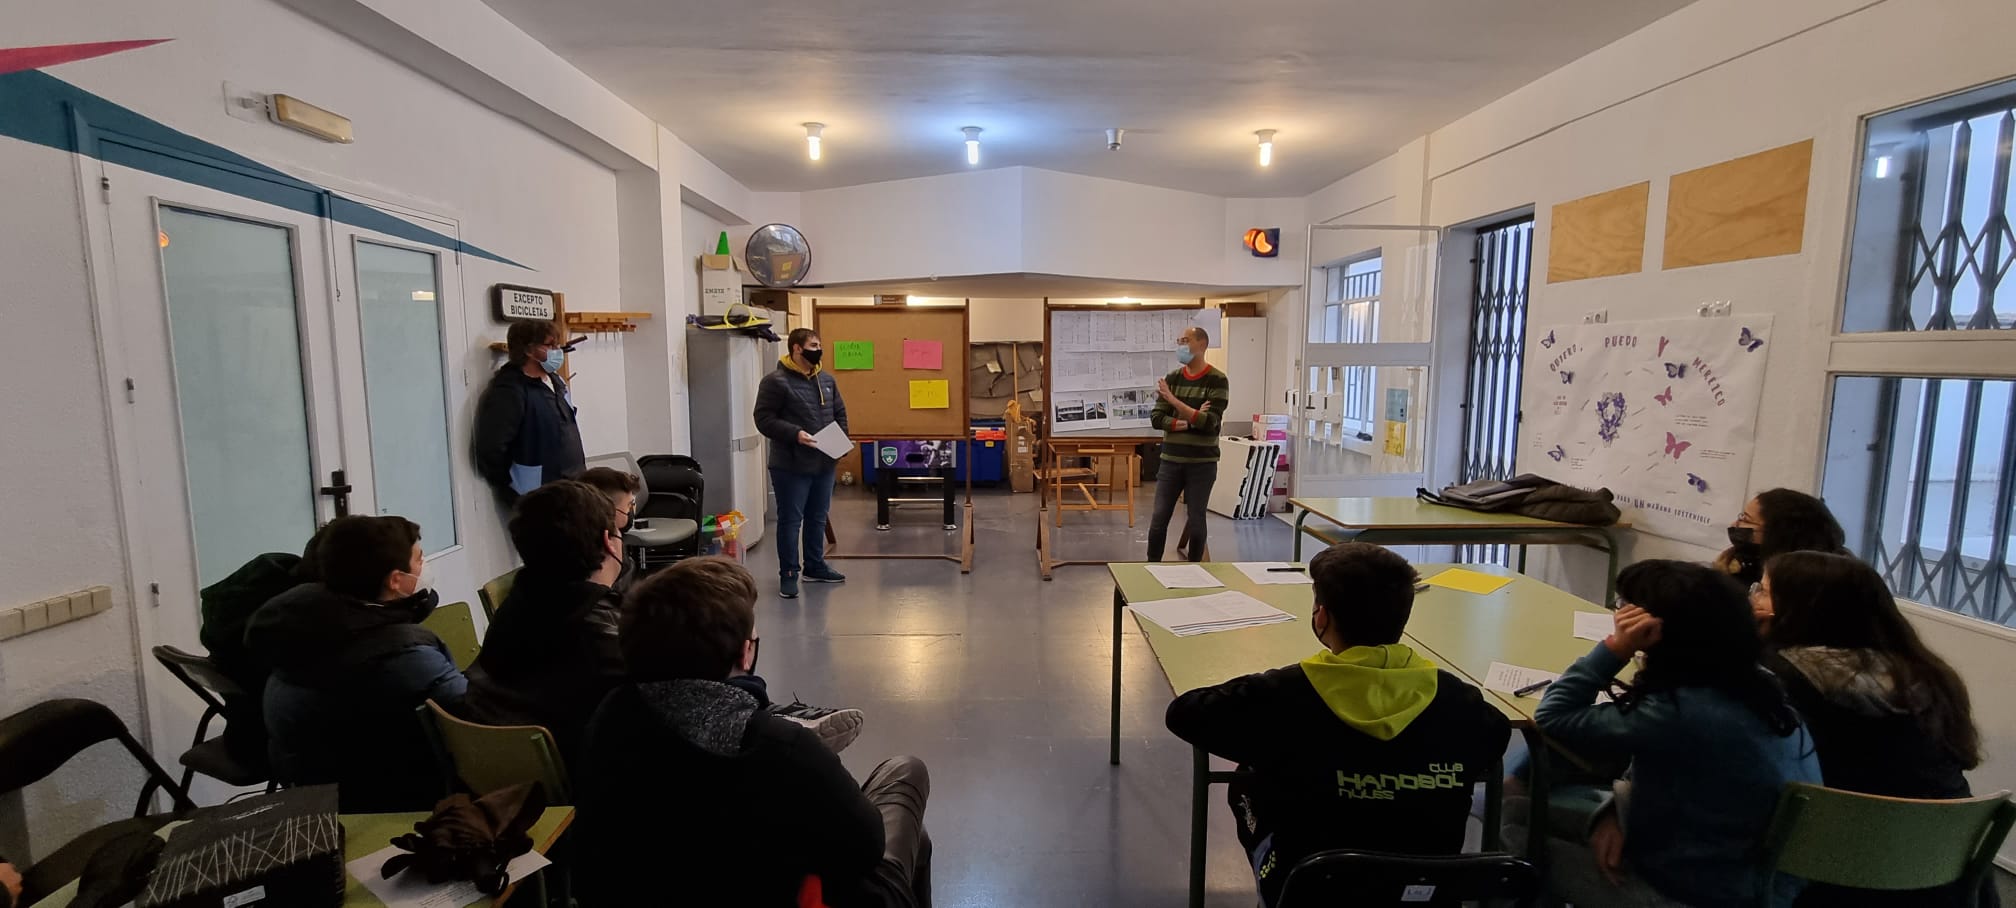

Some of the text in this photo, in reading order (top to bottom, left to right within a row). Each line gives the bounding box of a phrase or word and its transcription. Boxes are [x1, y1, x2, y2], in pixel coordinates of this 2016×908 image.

[514, 293, 543, 305] EXCEPTO
[510, 305, 548, 317] BICICLETAS
[1605, 336, 1637, 348] PUEDO
[1634, 499, 1645, 508] UN
[1429, 763, 1463, 773] CLUB
[1336, 770, 1464, 790] HANDBOL
